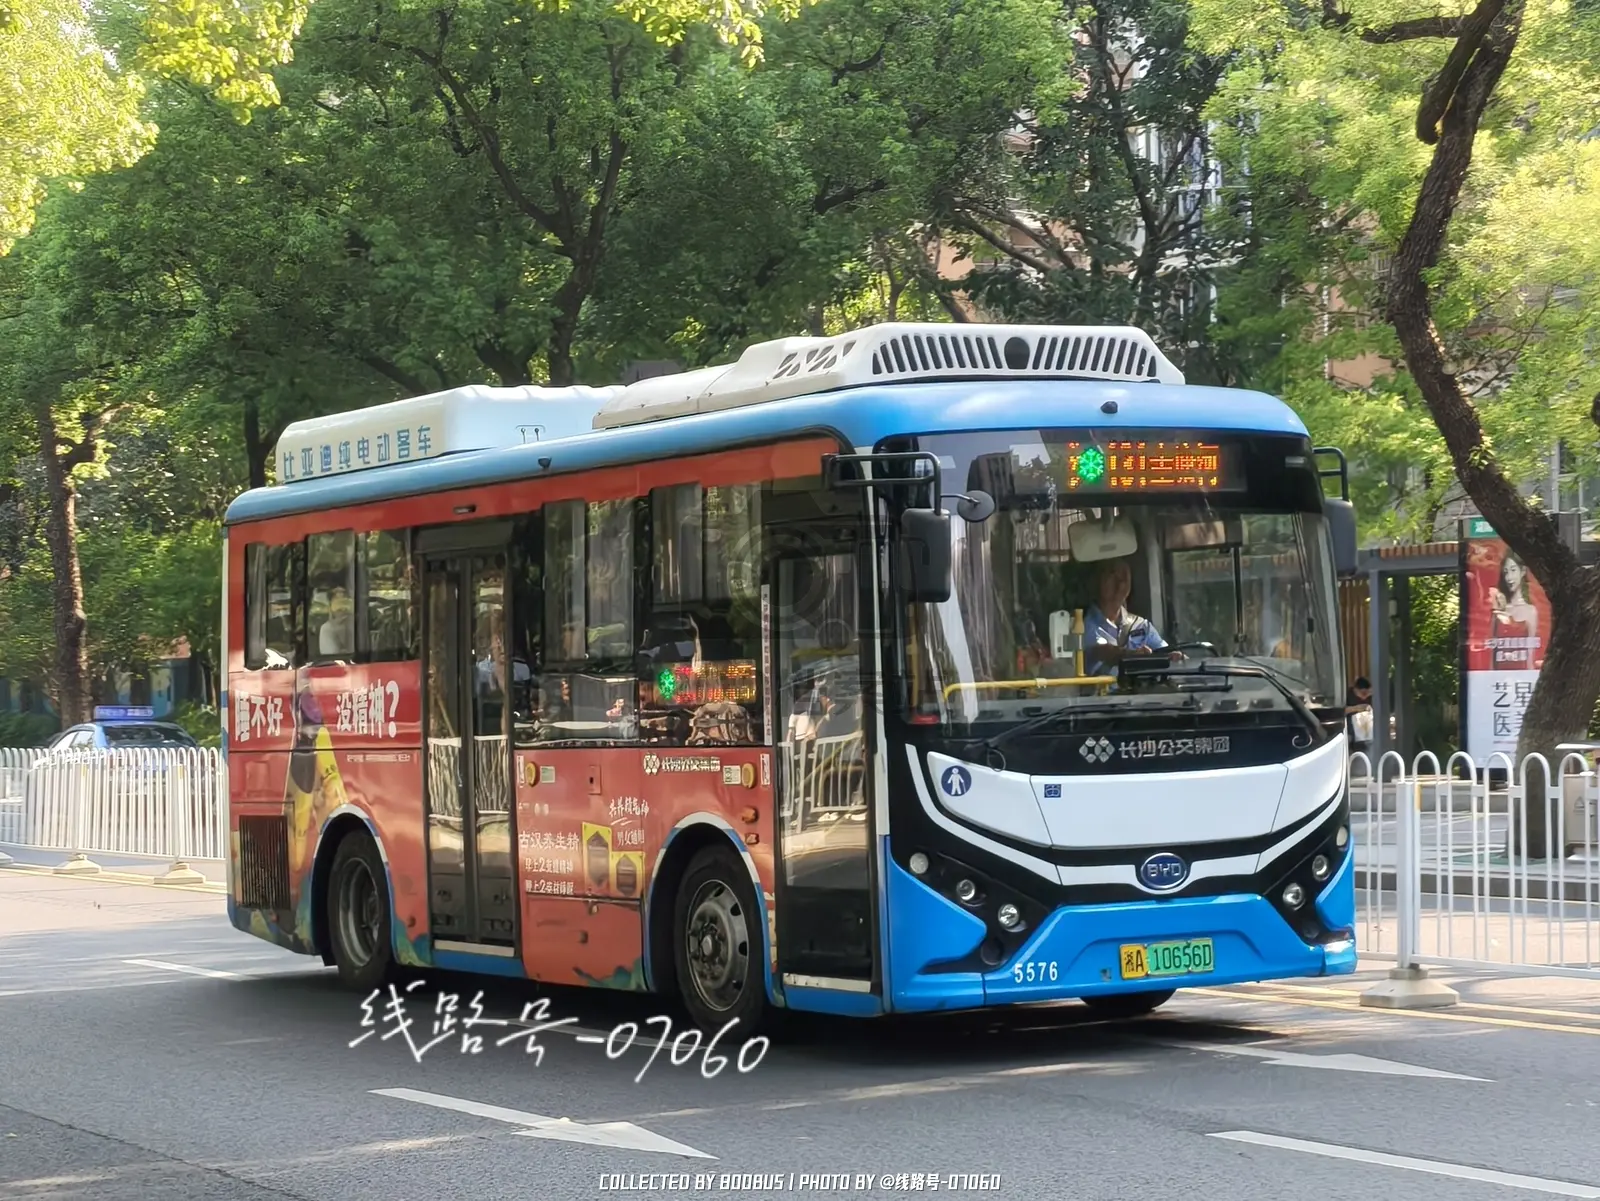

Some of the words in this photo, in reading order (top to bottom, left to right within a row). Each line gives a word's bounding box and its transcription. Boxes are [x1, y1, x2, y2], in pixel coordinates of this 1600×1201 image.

[282, 425, 432, 480] 比亚迪纯电动客车
[1119, 736, 1230, 759] 长沙公交集团
[518, 830, 580, 850] 古汉养生精
[1146, 863, 1182, 877] BYD
[1153, 944, 1213, 971] 10656D
[1013, 961, 1059, 983] 5576
